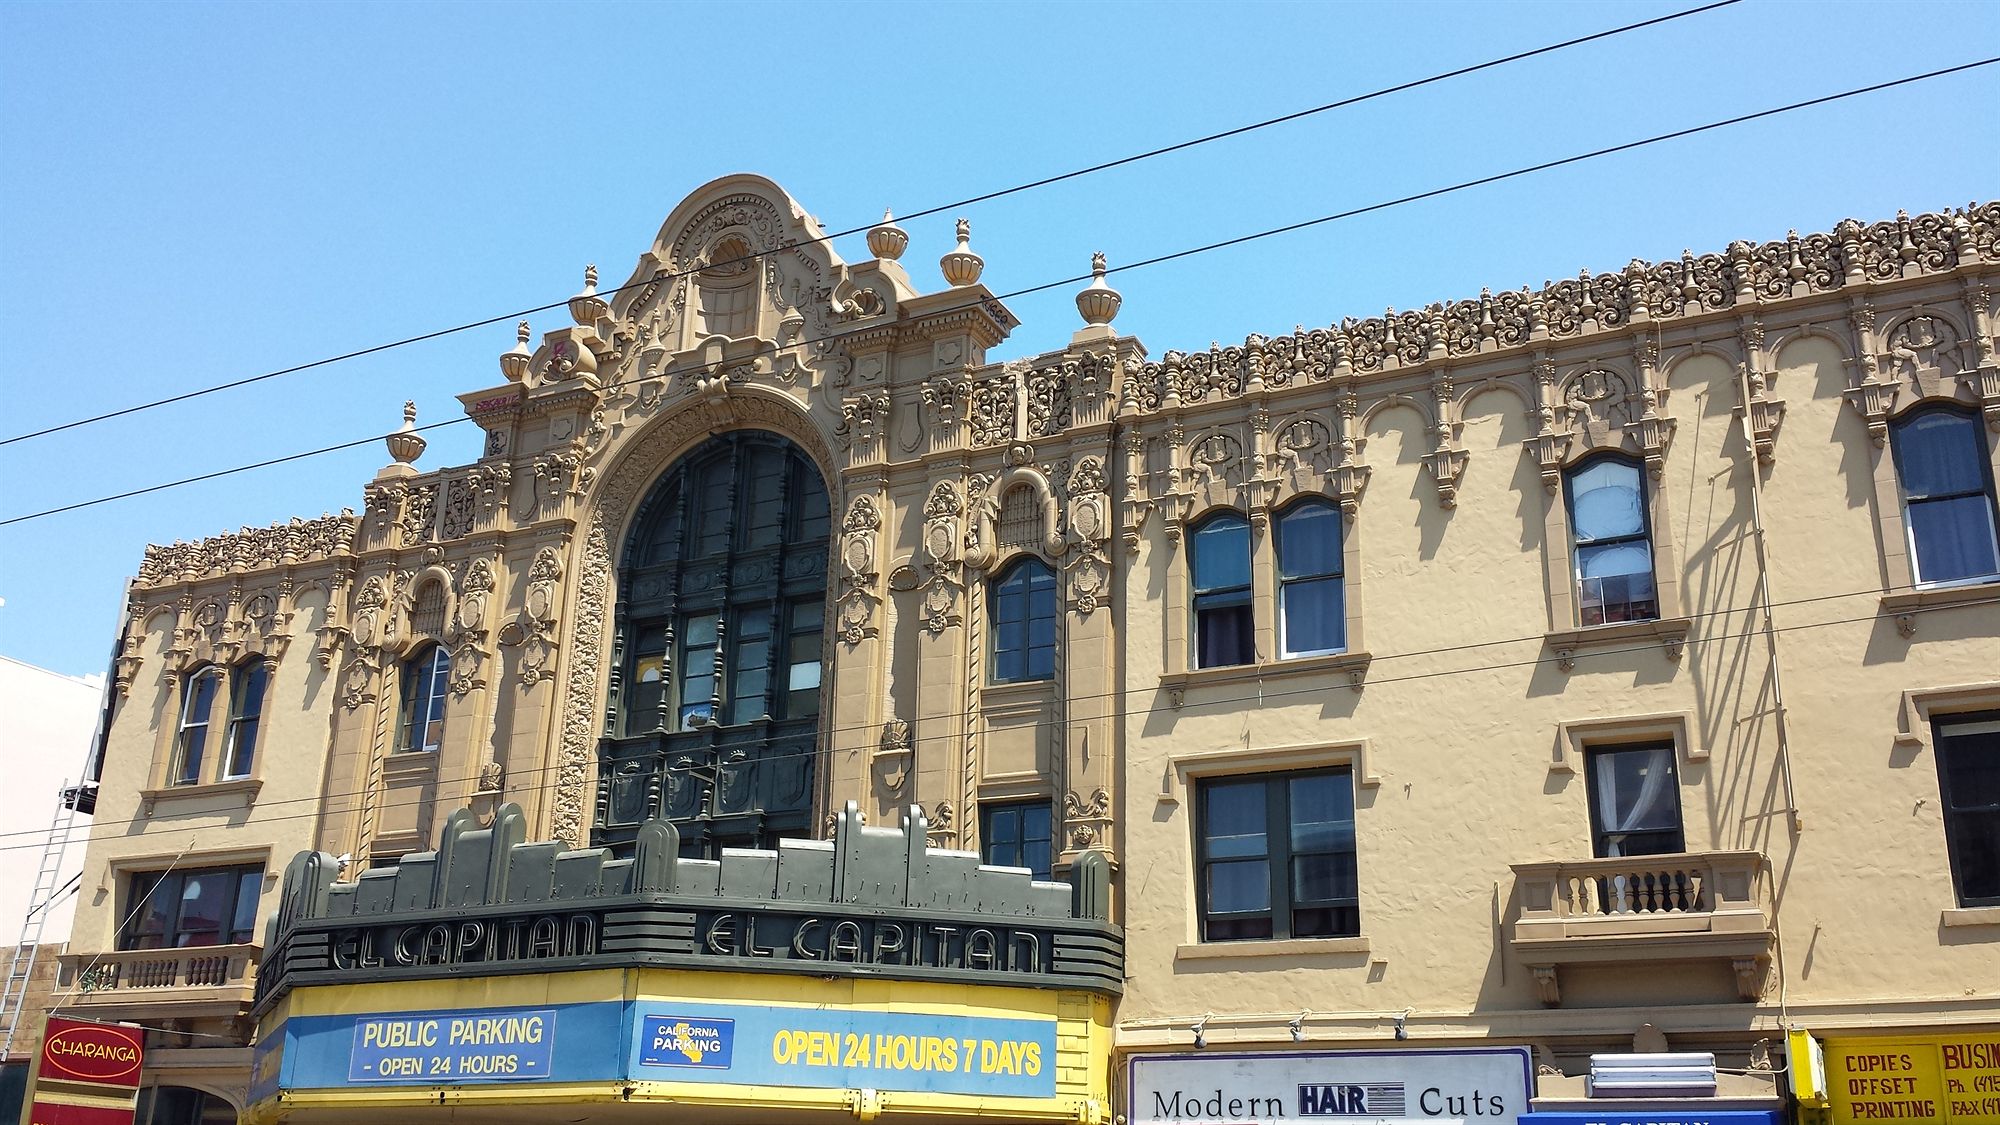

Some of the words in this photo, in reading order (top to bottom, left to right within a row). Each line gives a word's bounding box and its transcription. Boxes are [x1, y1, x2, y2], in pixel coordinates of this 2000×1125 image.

[334, 928, 384, 970] EL
[395, 914, 599, 967] CAPITAN
[706, 914, 776, 957] EL
[793, 918, 1040, 973] CAPITAN
[363, 1020, 438, 1048] PUBLIC
[449, 1016, 542, 1045] PARKING
[658, 1025, 719, 1037] CALIFORNIA
[50, 1038, 137, 1063] CHARANGA
[653, 1037, 721, 1053] PARKING
[772, 1030, 840, 1067] OPEN
[843, 1033, 871, 1068] 24
[875, 1034, 958, 1072] HOURS
[963, 1039, 977, 1073] 7
[980, 1040, 1042, 1076] DAYS
[379, 1057, 423, 1076] OPEN
[430, 1056, 451, 1075] 24
[459, 1054, 518, 1074] HOURS
[1845, 1054, 1913, 1073] COPIES
[1849, 1077, 1917, 1096] OFFSET
[1152, 1089, 1285, 1118] Modern
[1300, 1085, 1369, 1115] HAIR
[1420, 1087, 1505, 1117] Cuts
[1850, 1100, 1936, 1119] PRINTING
[1951, 1101, 1980, 1116] FAX
